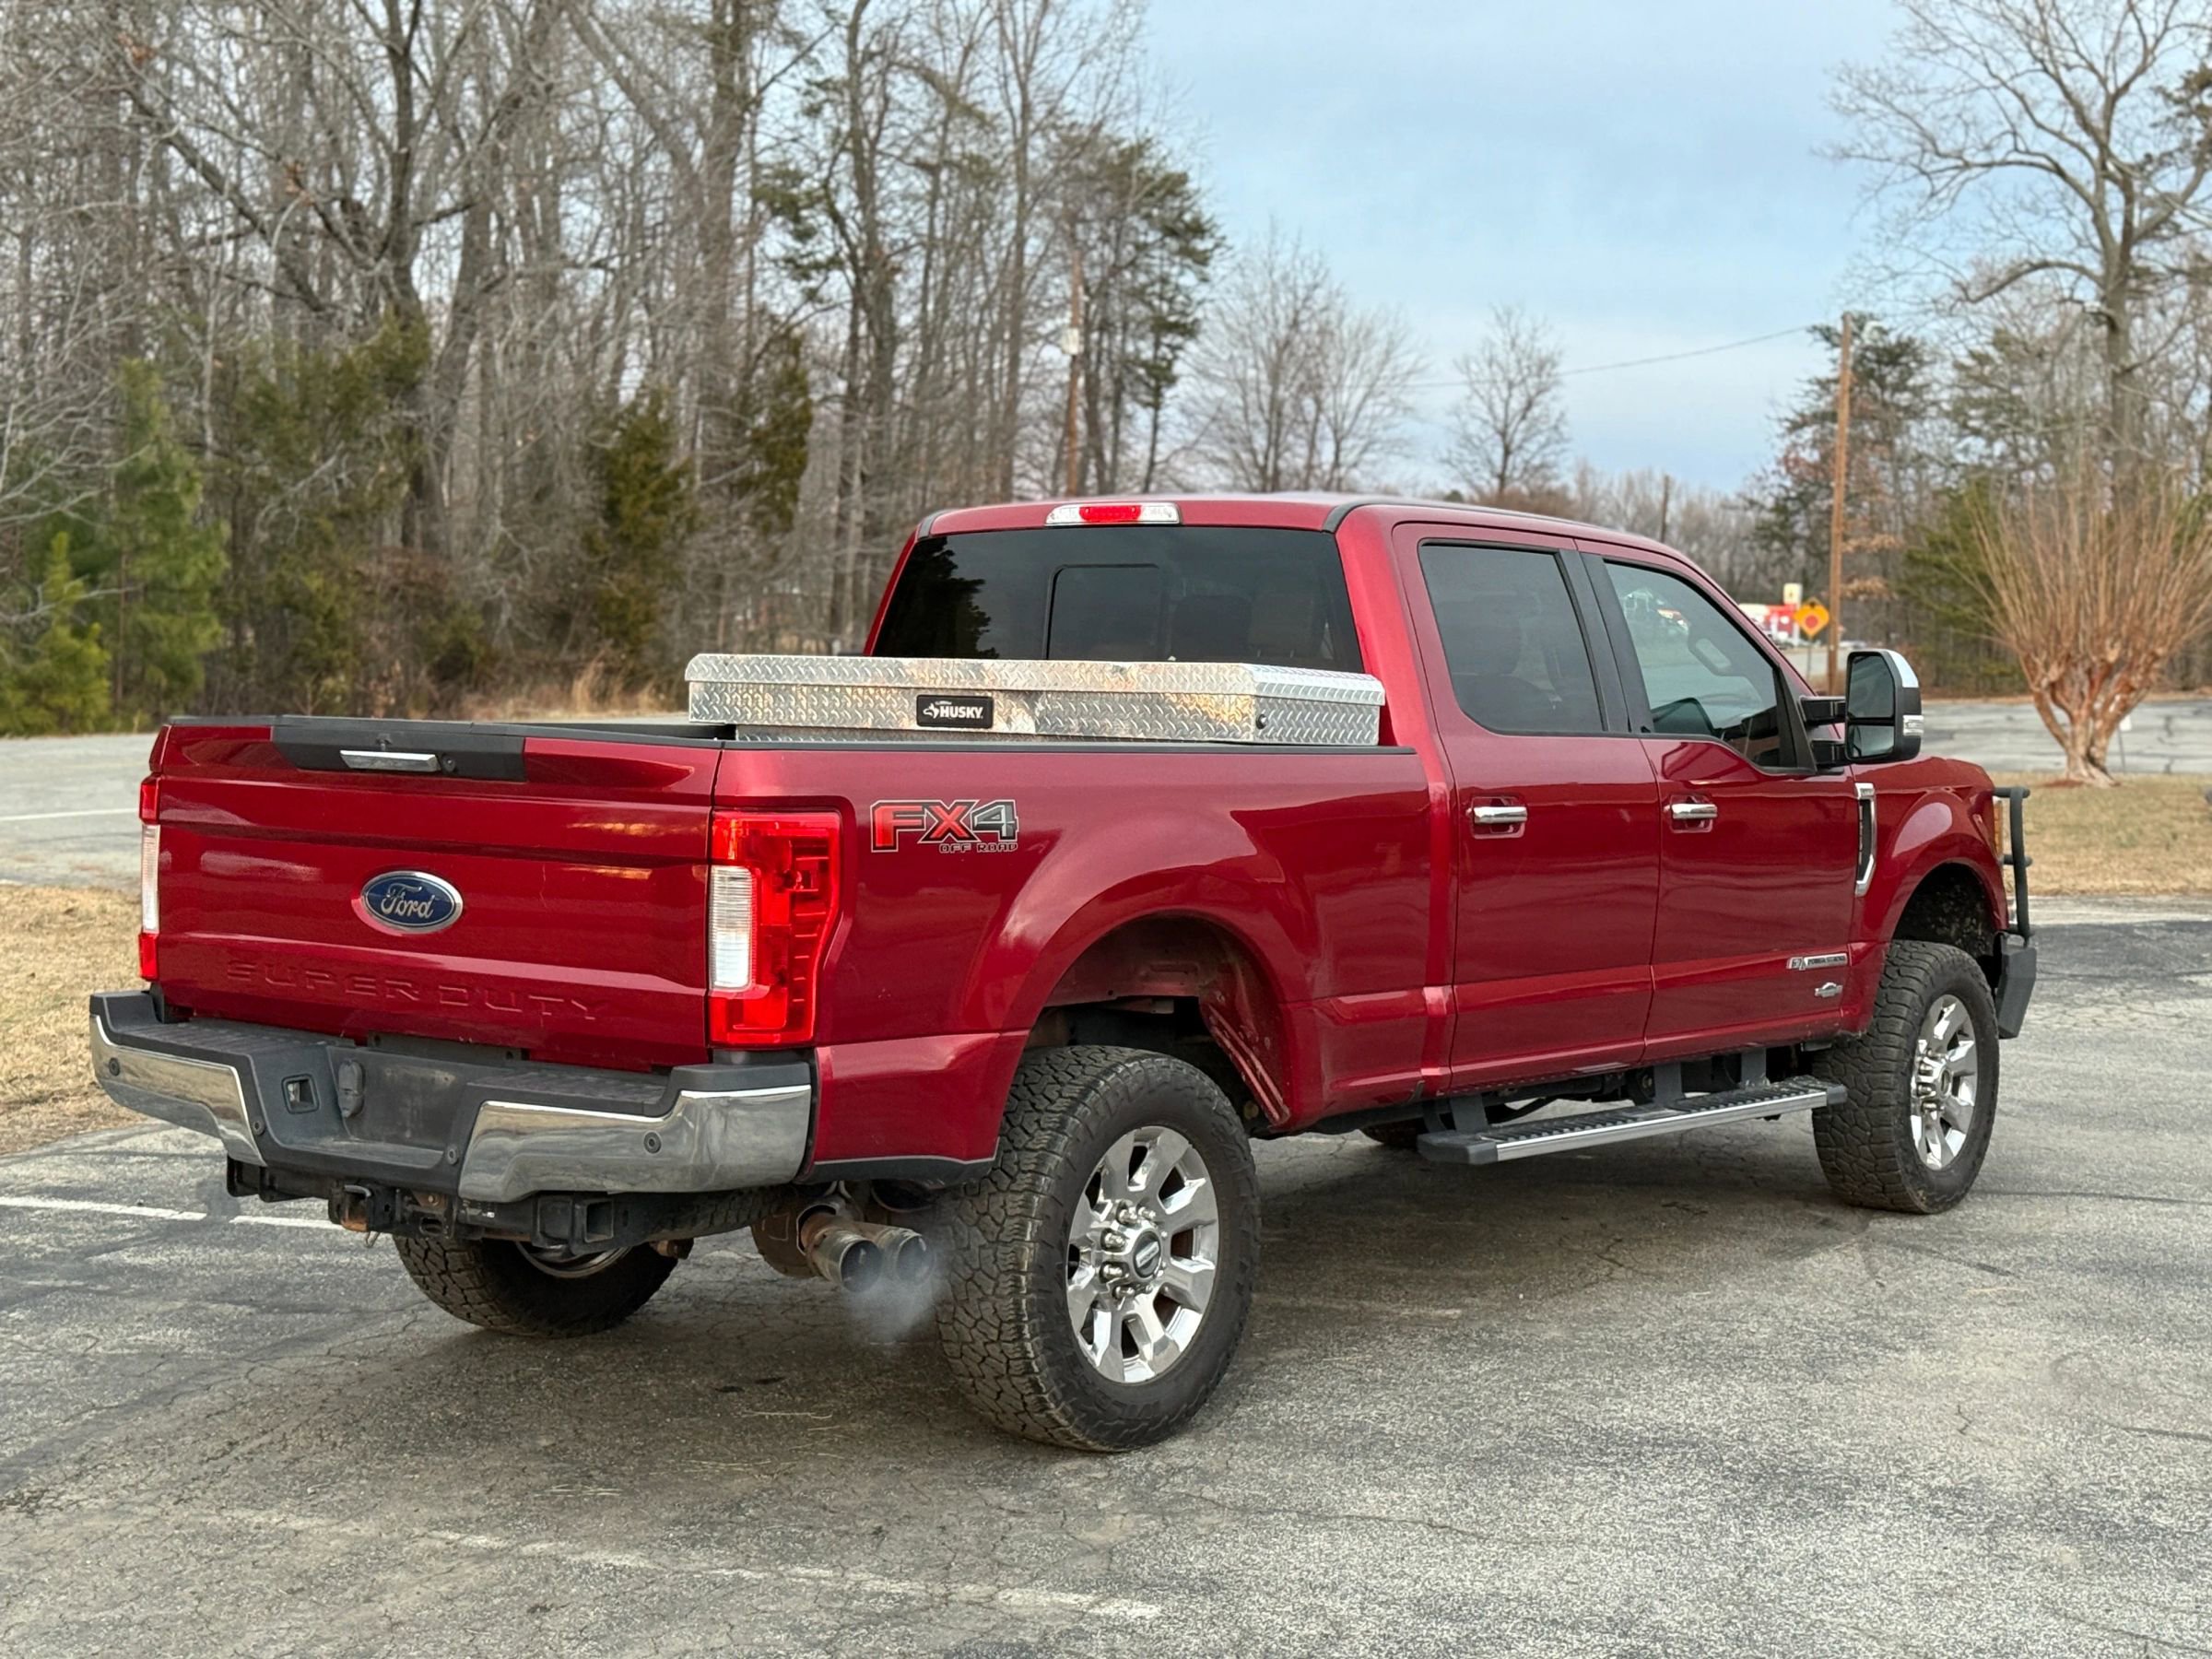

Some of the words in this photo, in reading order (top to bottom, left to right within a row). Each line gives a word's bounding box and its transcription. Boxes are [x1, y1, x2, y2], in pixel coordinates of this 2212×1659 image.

[939, 705, 983, 719] HUSKY
[870, 799, 1019, 853] FX4
[938, 842, 971, 853] OFF
[976, 841, 1018, 853] ROAD
[381, 883, 435, 919] Ford
[226, 962, 420, 1002] SUPER
[438, 983, 608, 1021] DUTY
